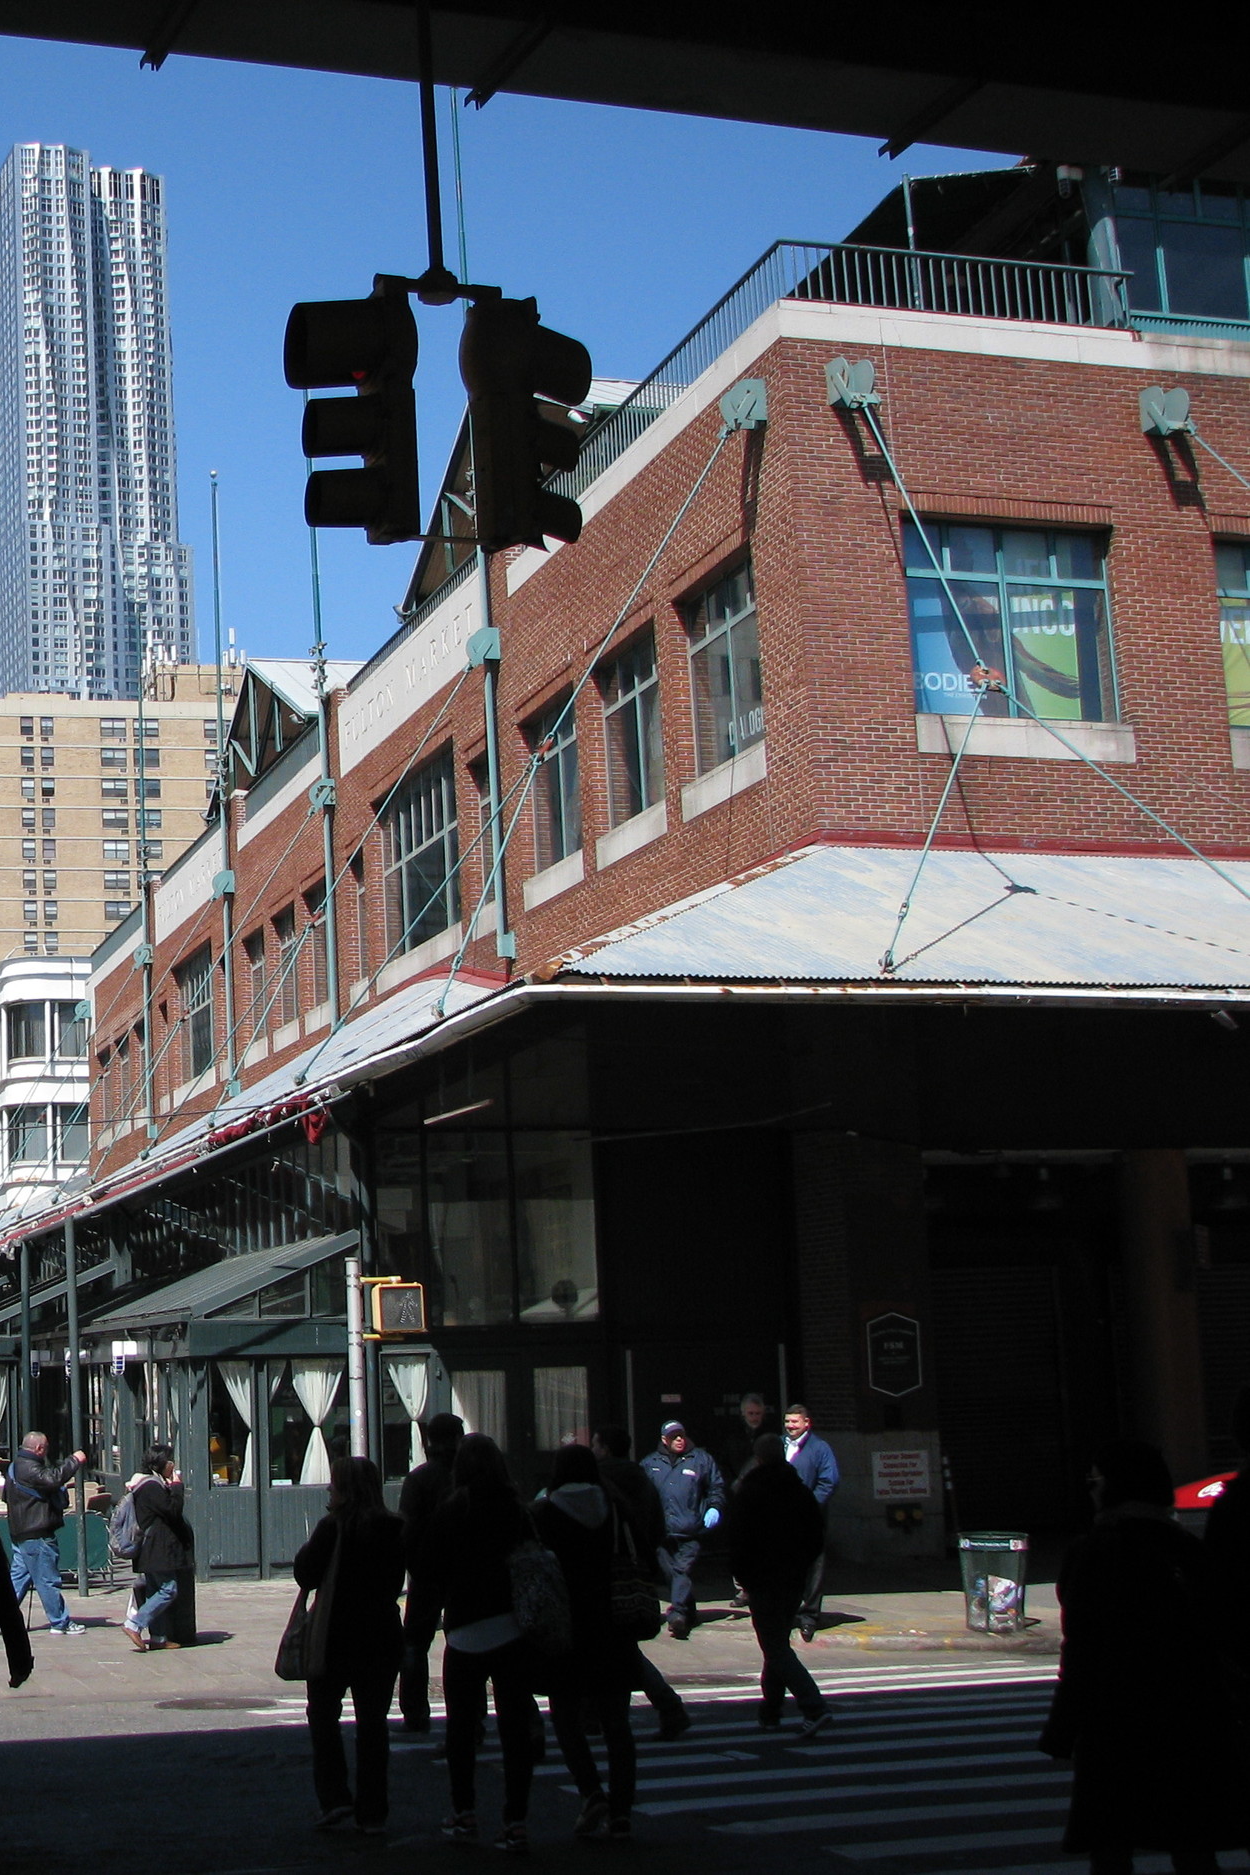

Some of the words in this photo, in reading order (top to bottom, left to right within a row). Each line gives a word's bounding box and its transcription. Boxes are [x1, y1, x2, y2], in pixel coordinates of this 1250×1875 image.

[345, 679, 394, 749] FULTON
[404, 602, 473, 694] MARKET
[914, 672, 982, 692] BODIE
